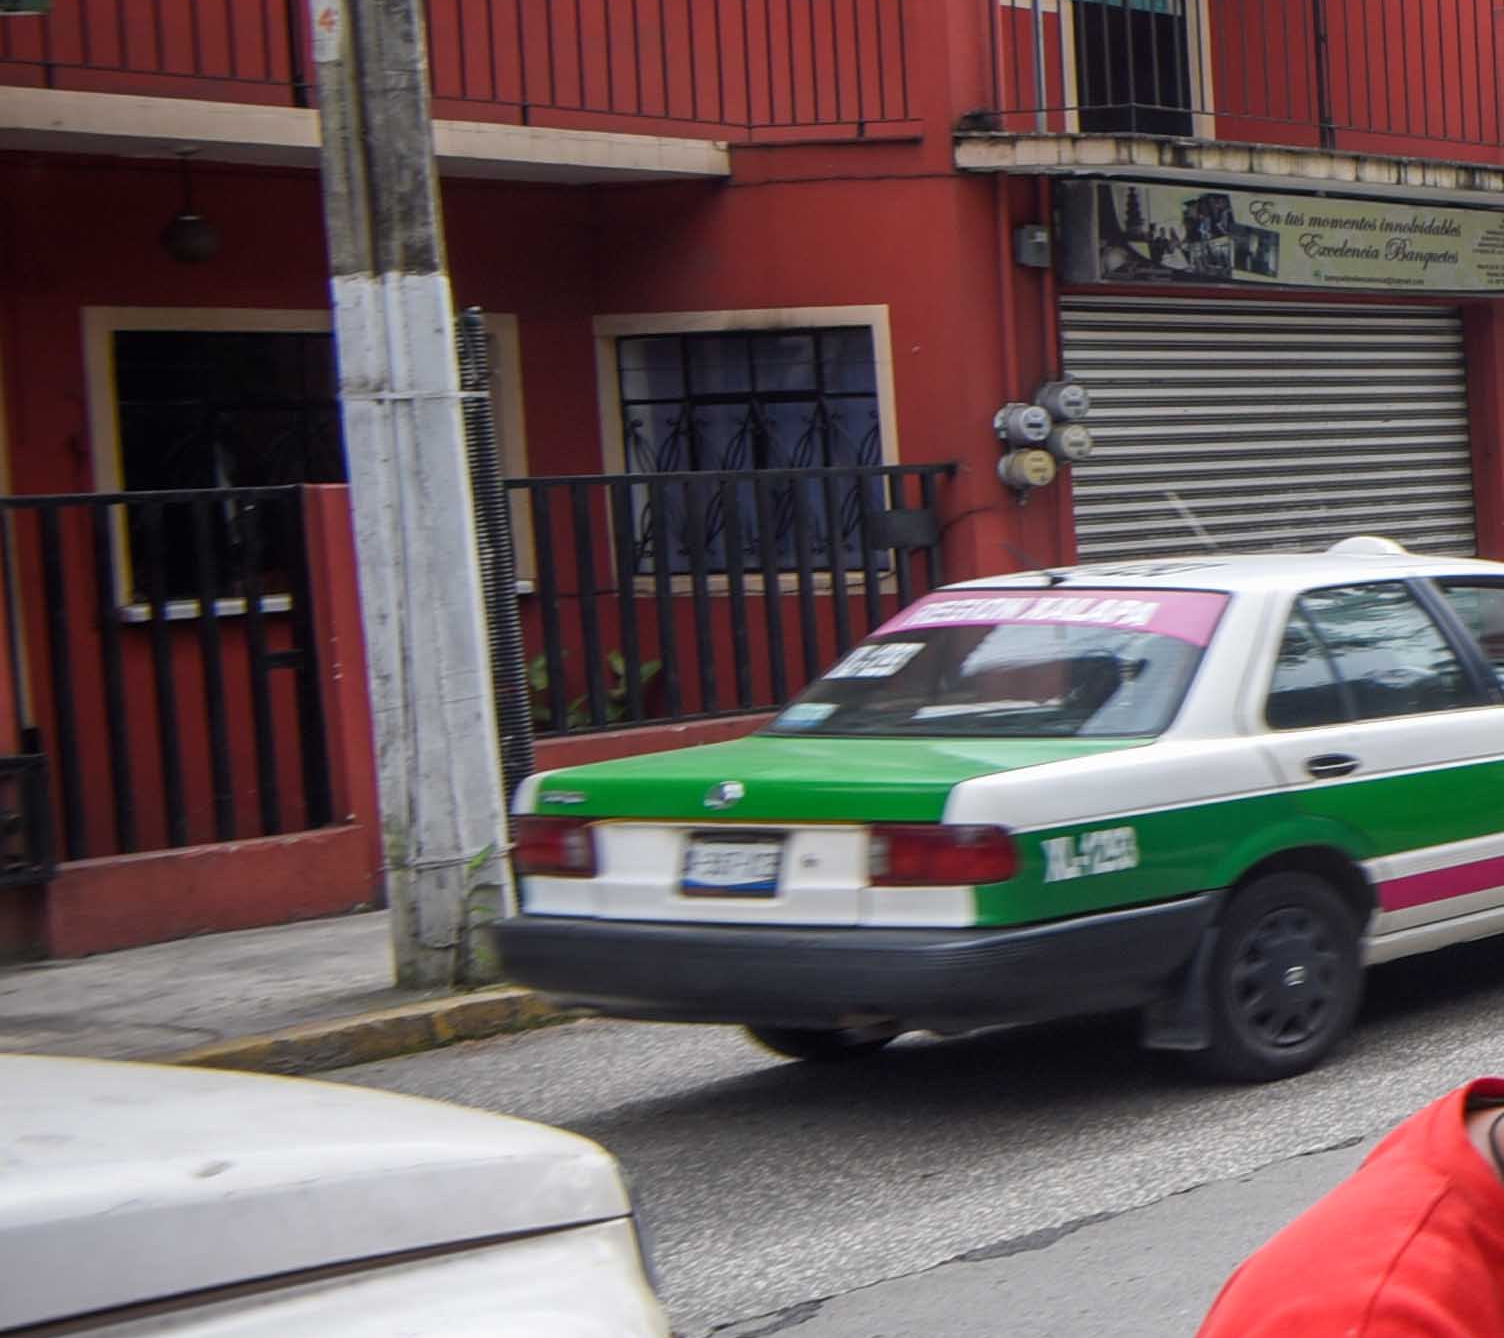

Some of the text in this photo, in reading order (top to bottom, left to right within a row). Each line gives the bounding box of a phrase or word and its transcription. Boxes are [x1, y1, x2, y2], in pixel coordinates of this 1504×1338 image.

[1248, 200, 1282, 227] En
[1284, 212, 1305, 227] tus
[1307, 214, 1377, 232] momentos
